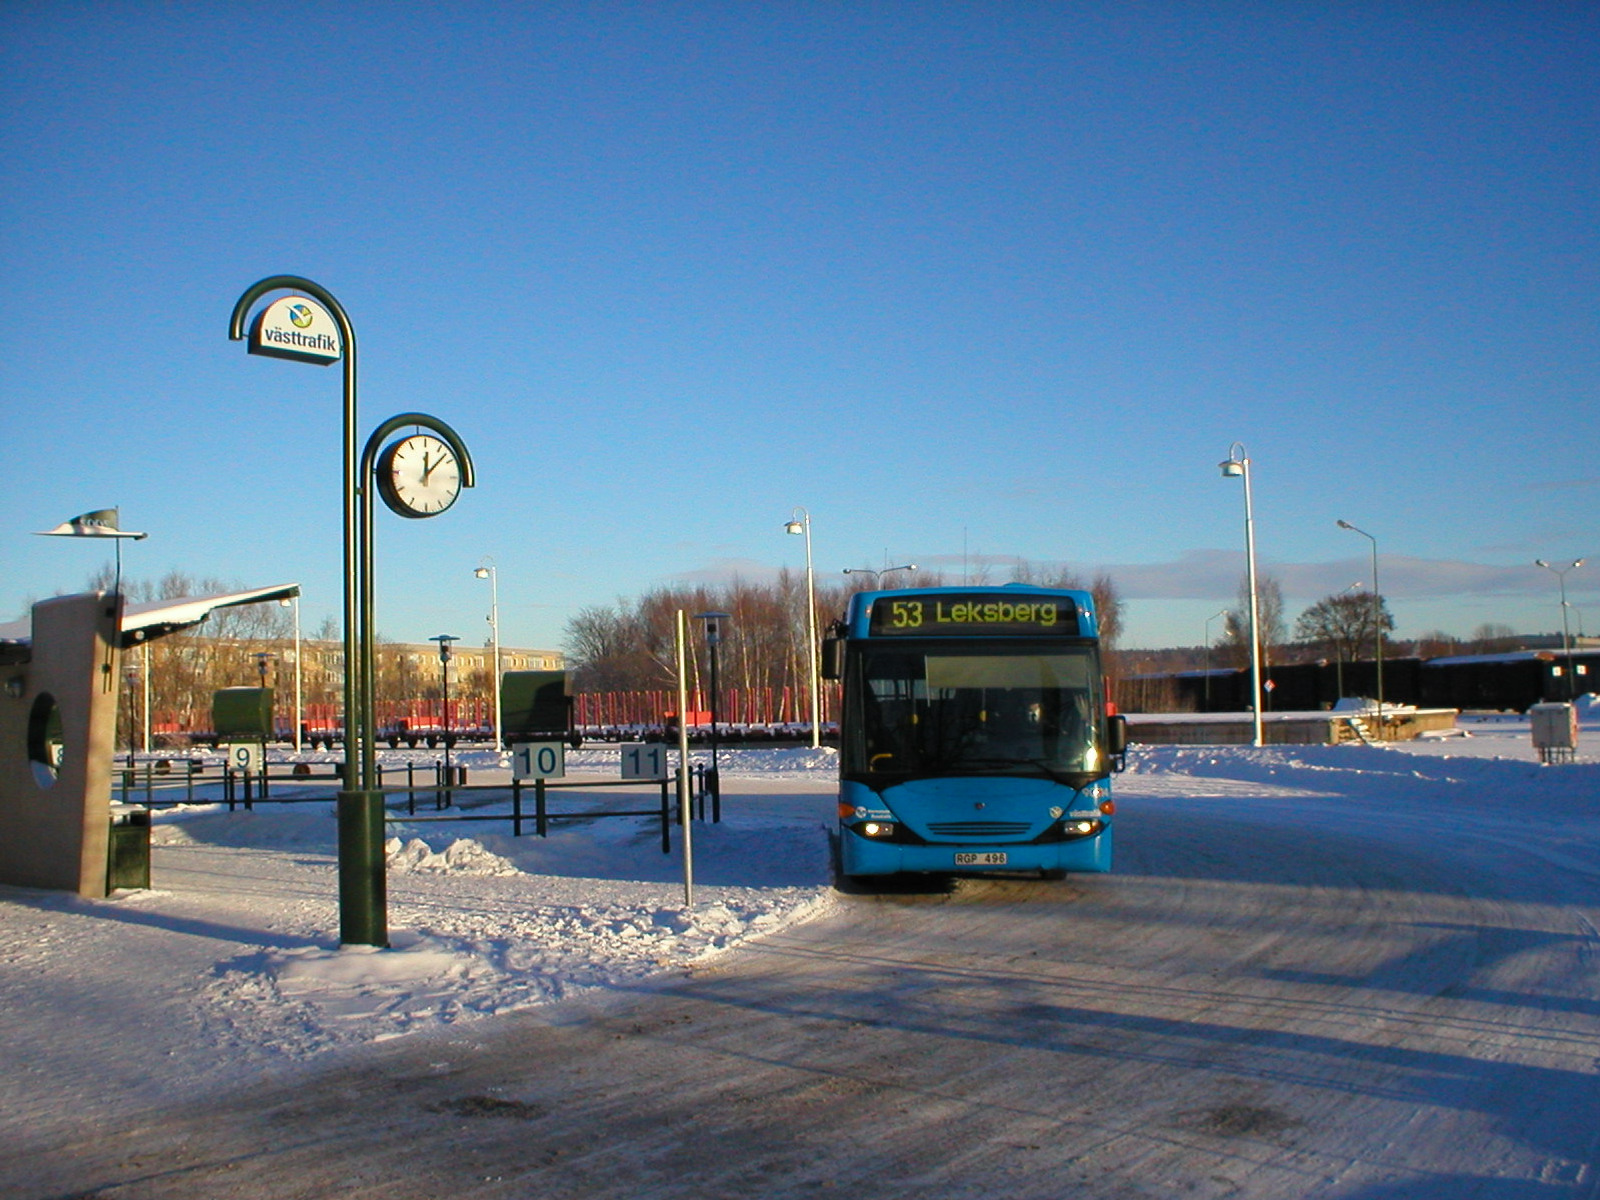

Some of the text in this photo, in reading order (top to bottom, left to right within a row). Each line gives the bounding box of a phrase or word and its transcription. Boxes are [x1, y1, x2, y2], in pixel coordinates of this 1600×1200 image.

[265, 326, 336, 351] västtrafik
[892, 601, 1057, 628] 53 Leksberg
[236, 747, 250, 769] 9
[519, 747, 556, 774] 10
[629, 749, 658, 774] 11
[957, 854, 977, 863] RGP
